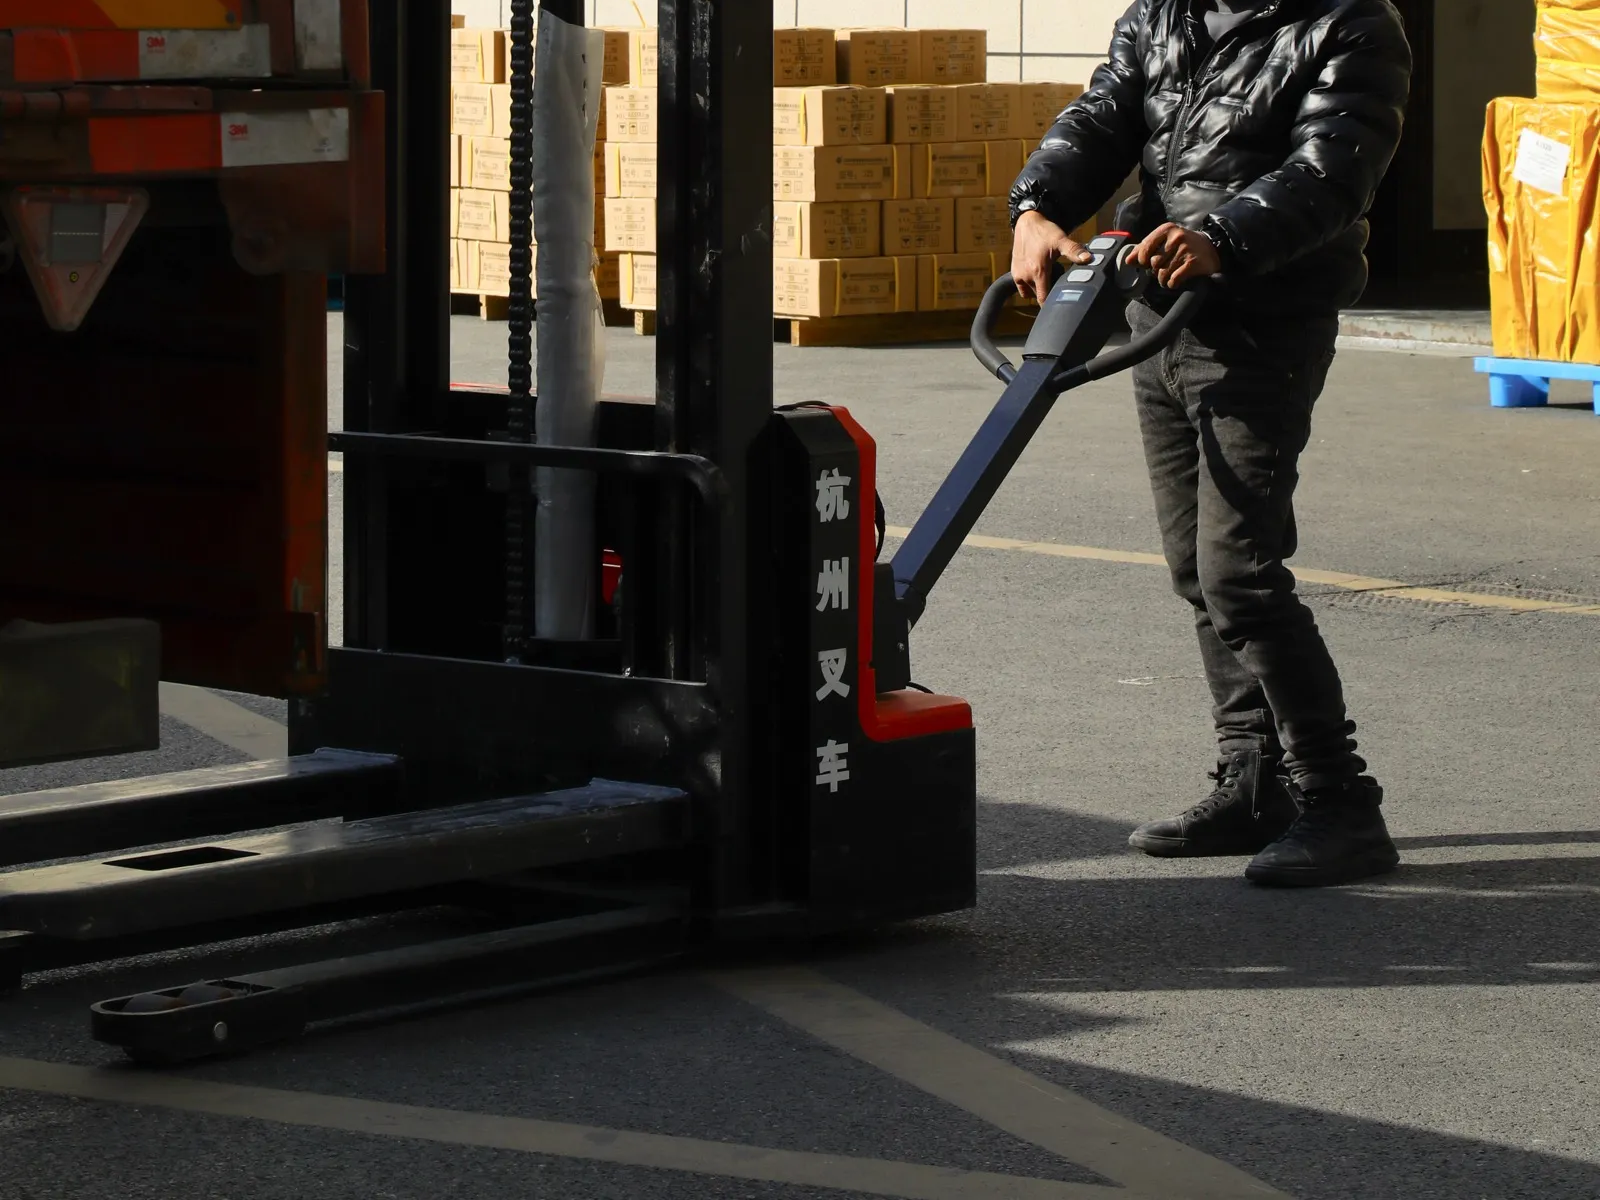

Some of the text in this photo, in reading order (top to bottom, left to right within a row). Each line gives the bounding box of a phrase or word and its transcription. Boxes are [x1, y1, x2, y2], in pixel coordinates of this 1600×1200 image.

[147, 37, 165, 47] 3M
[228, 124, 247, 135] 3M
[816, 468, 851, 792] 杭州叉车
